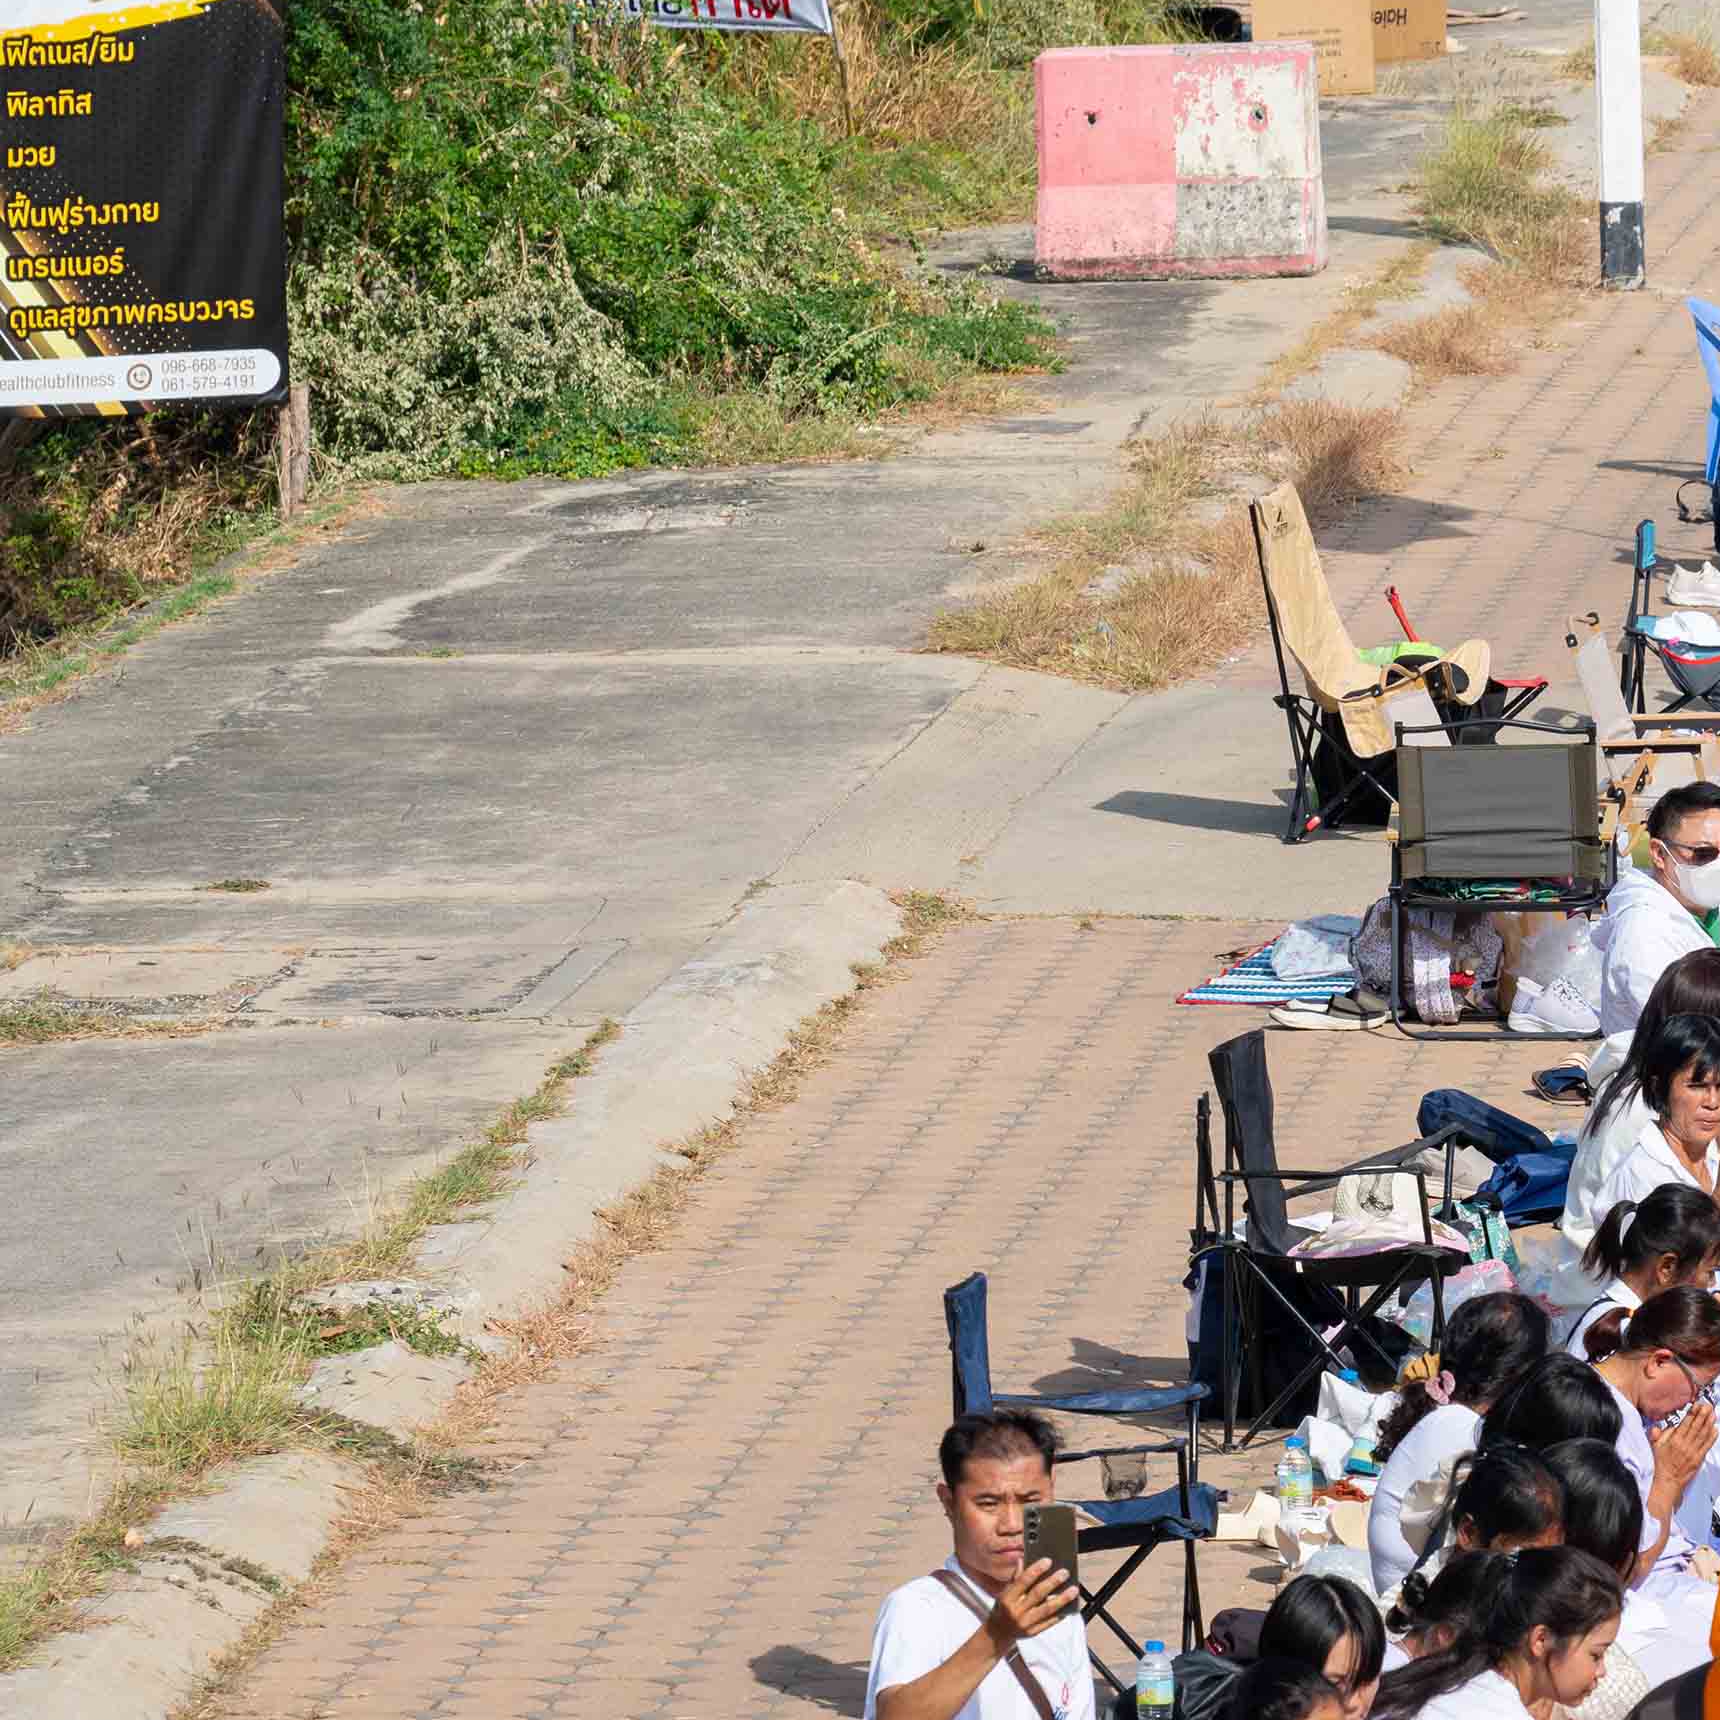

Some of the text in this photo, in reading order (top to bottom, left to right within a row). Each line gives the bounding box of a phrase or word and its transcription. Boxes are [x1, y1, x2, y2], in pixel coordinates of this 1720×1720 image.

[1371, 7, 1408, 26] Haie
[6, 35, 135, 68] ฟิตเนส/ยิม
[6, 89, 93, 118] พิลาทิส
[7, 144, 56, 168] มวย
[7, 191, 160, 235] ฟื้นฟูร่างกาย
[8, 247, 126, 280] เทรนเนอร์
[9, 298, 255, 336] ดูแลสุขภาพครบวงจร
